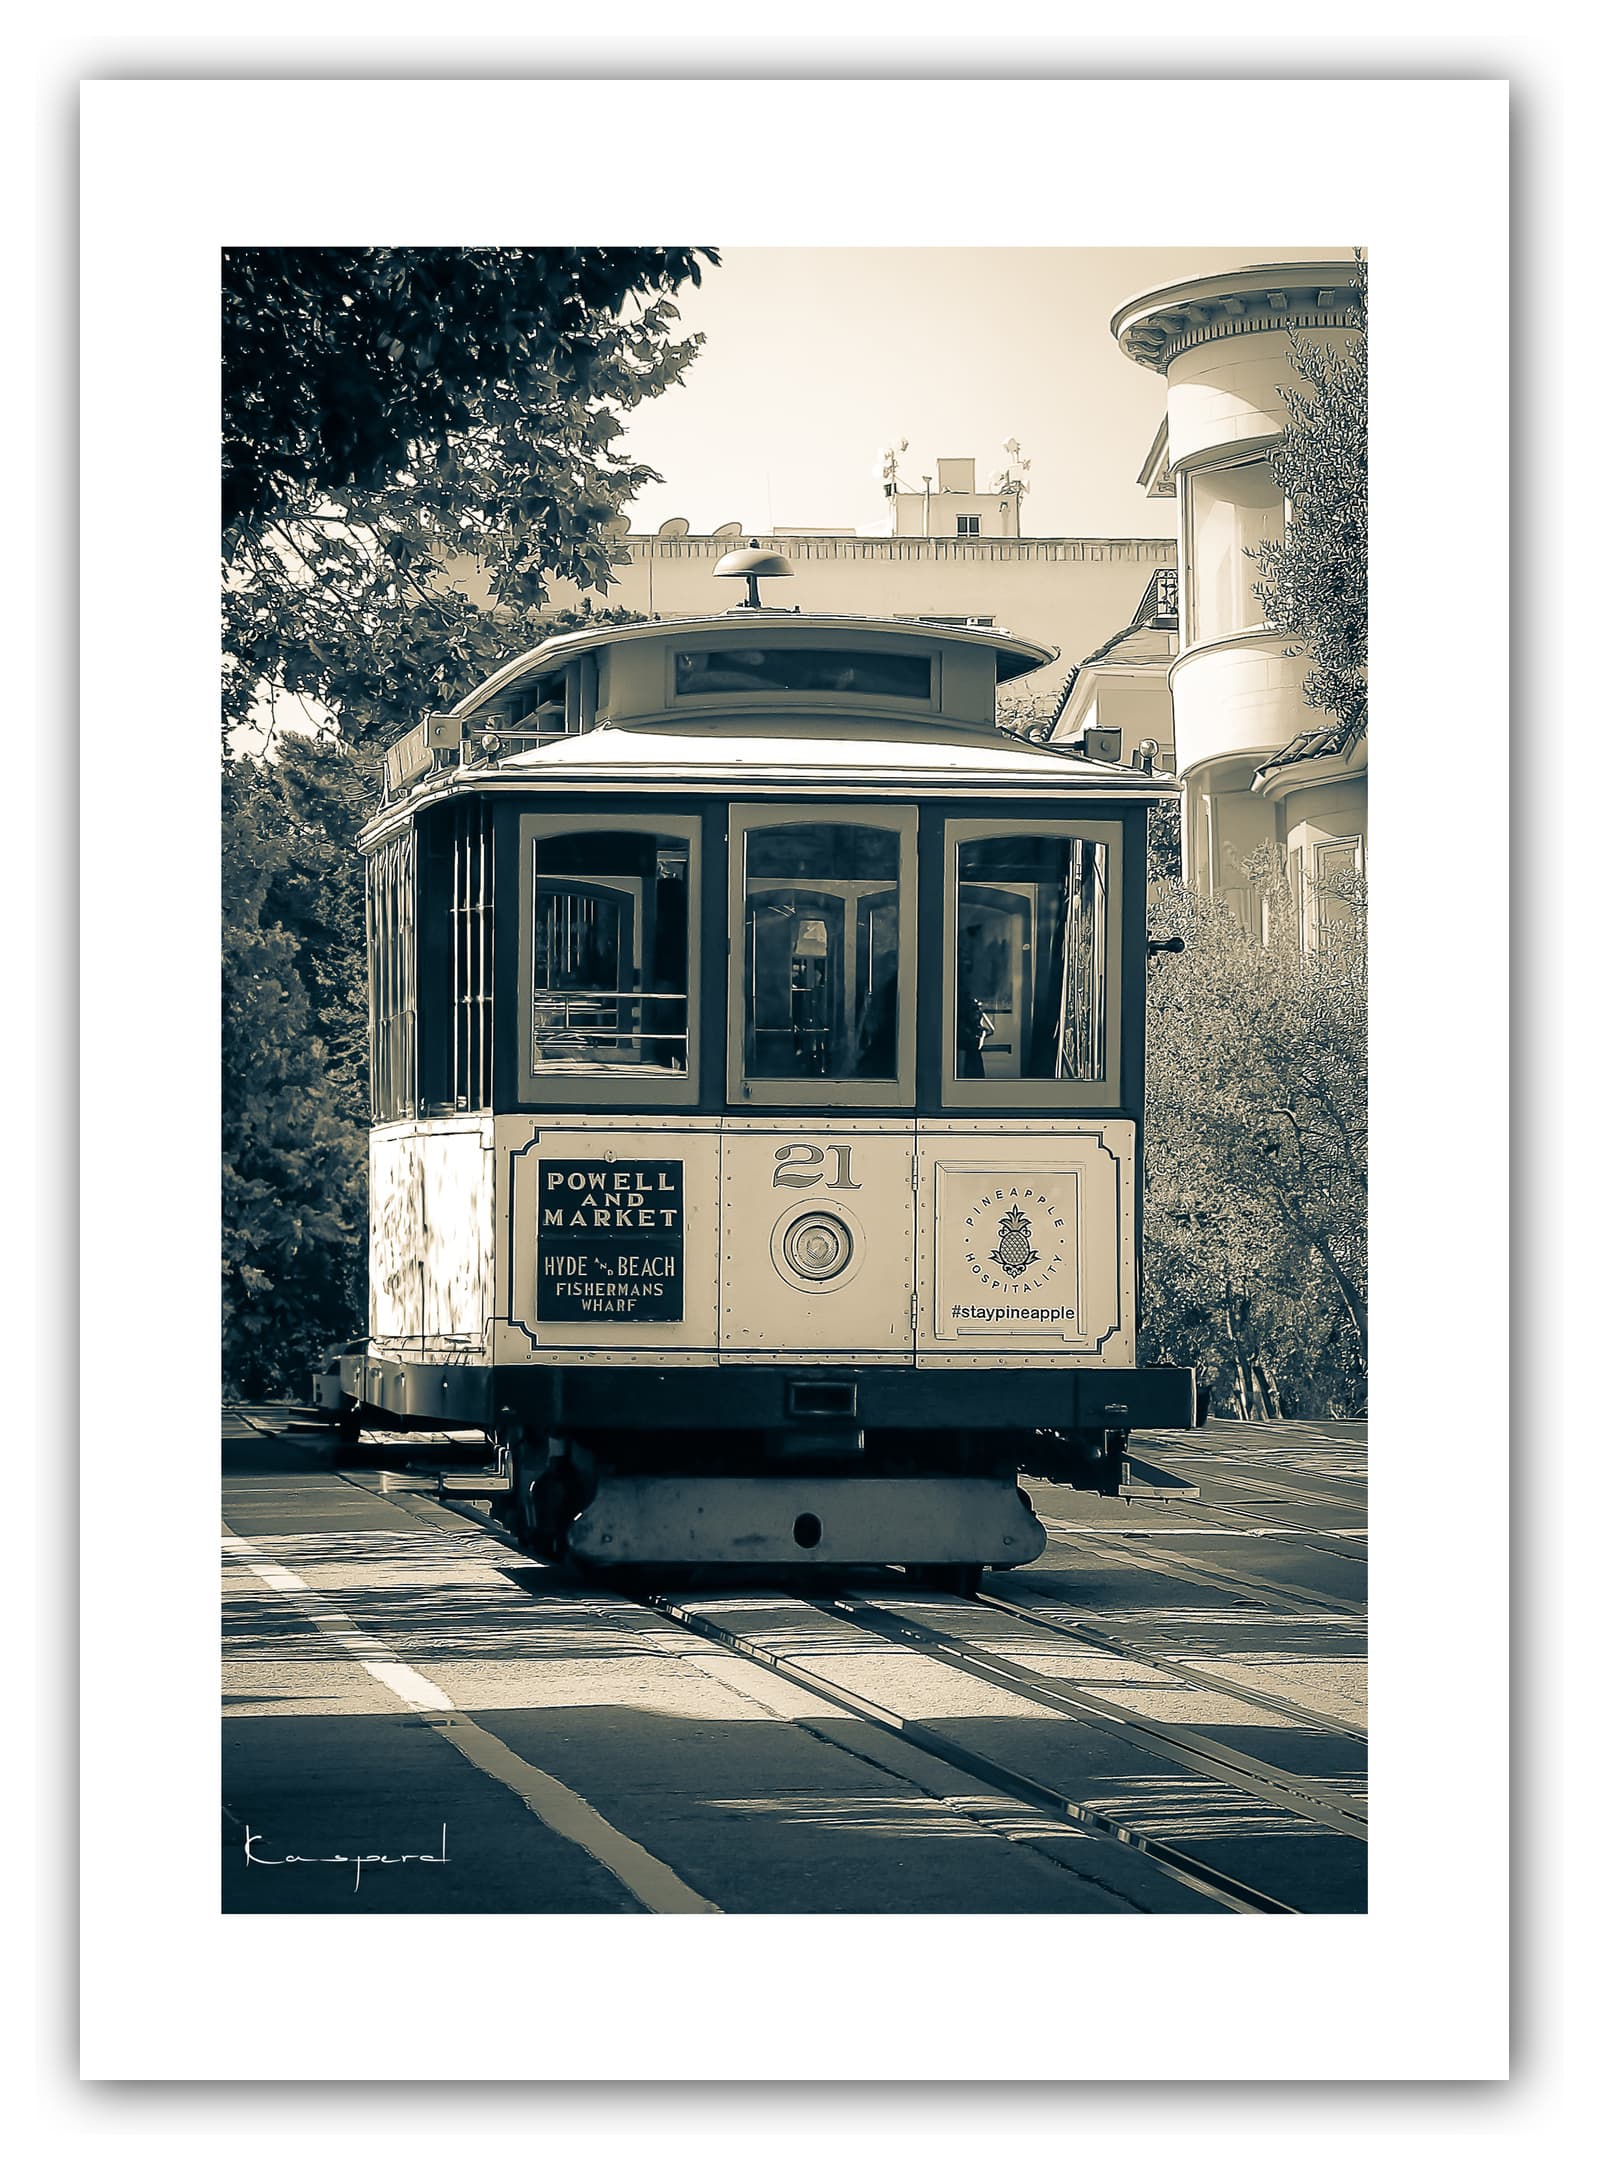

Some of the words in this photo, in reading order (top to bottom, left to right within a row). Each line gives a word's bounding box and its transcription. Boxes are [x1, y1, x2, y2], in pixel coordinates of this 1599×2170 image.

[773, 1143, 862, 1189] 21
[547, 1172, 675, 1191] POWELL
[581, 1193, 645, 1207] AND
[965, 1187, 1065, 1228] PINEAPPLE
[543, 1208, 678, 1227] MARKET
[544, 1256, 588, 1276] HYDE
[594, 1257, 614, 1276] AND
[618, 1256, 675, 1277] BEACH
[965, 1252, 1063, 1293] HOSPITALITY
[556, 1282, 664, 1296] FISHERMANS
[581, 1299, 637, 1312] WHARF
[952, 1304, 1076, 1322] #staypineapple
